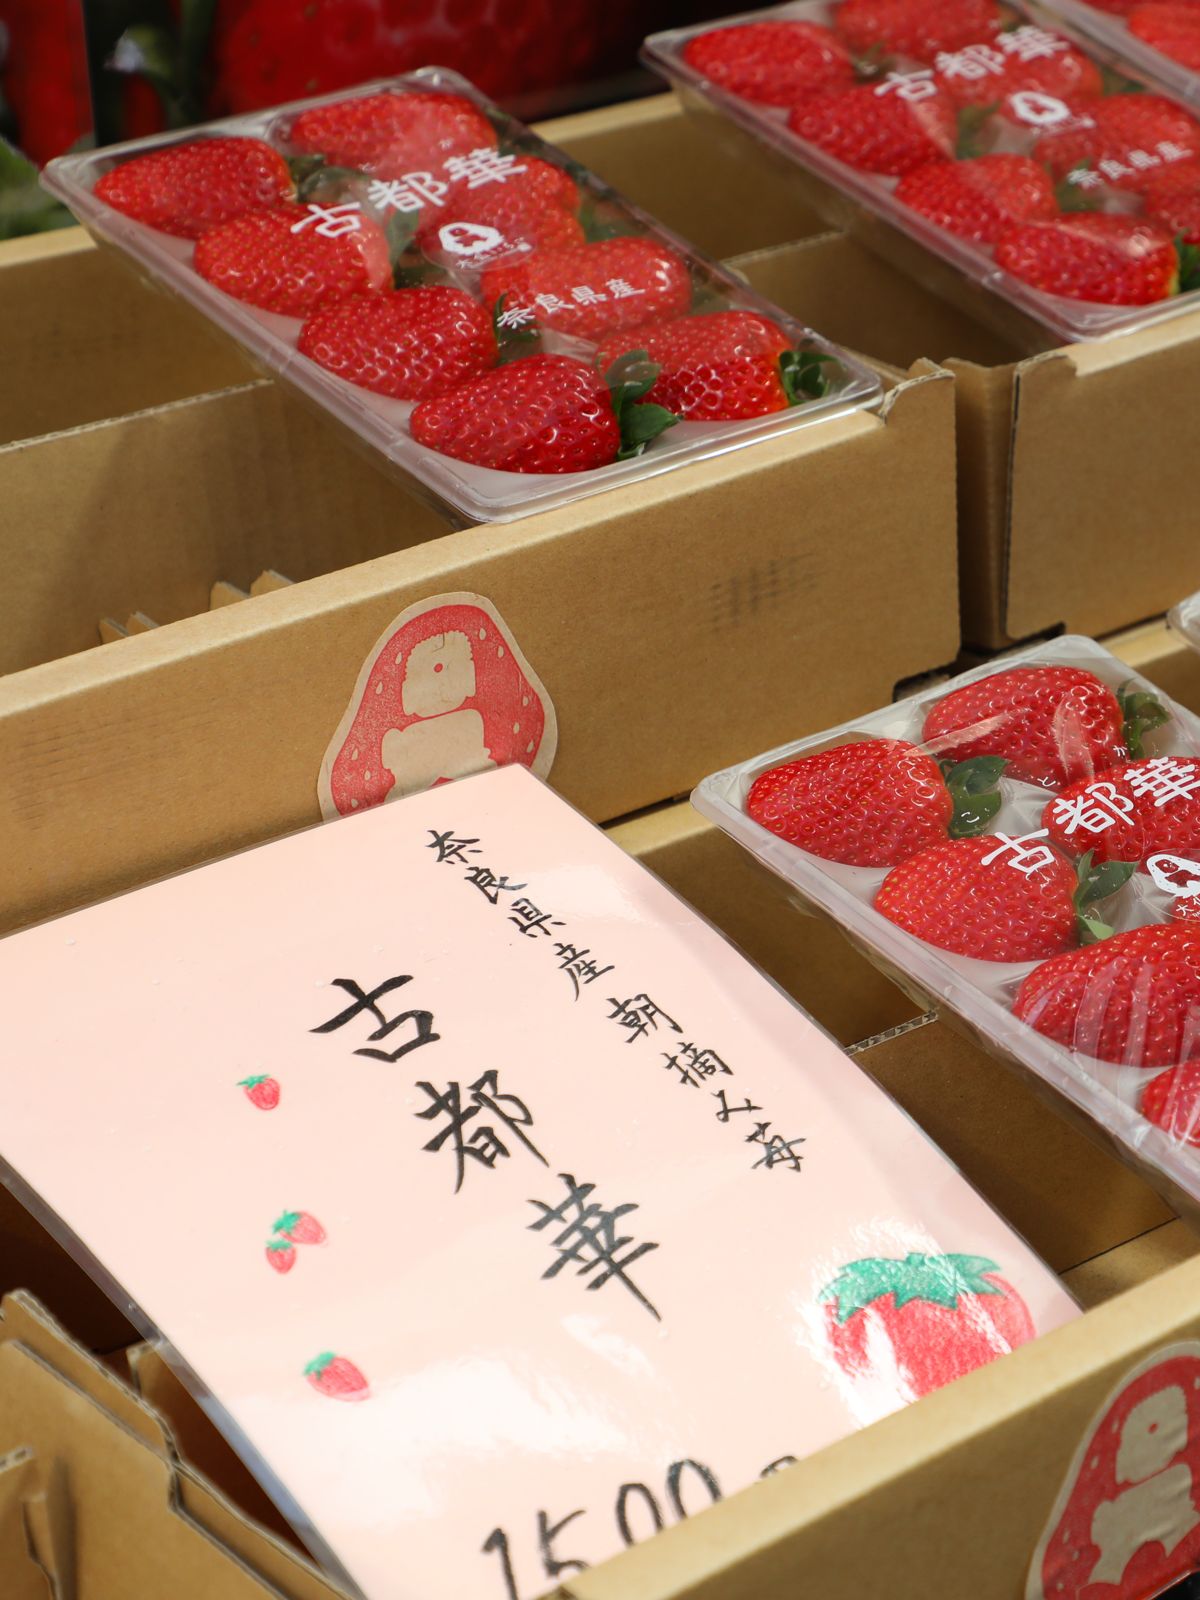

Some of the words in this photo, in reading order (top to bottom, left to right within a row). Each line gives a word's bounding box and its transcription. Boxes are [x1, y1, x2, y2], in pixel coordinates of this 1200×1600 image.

[290, 147, 528, 238] 古都華
[497, 277, 645, 330] 奈良県産
[309, 973, 663, 1322] 古都華
